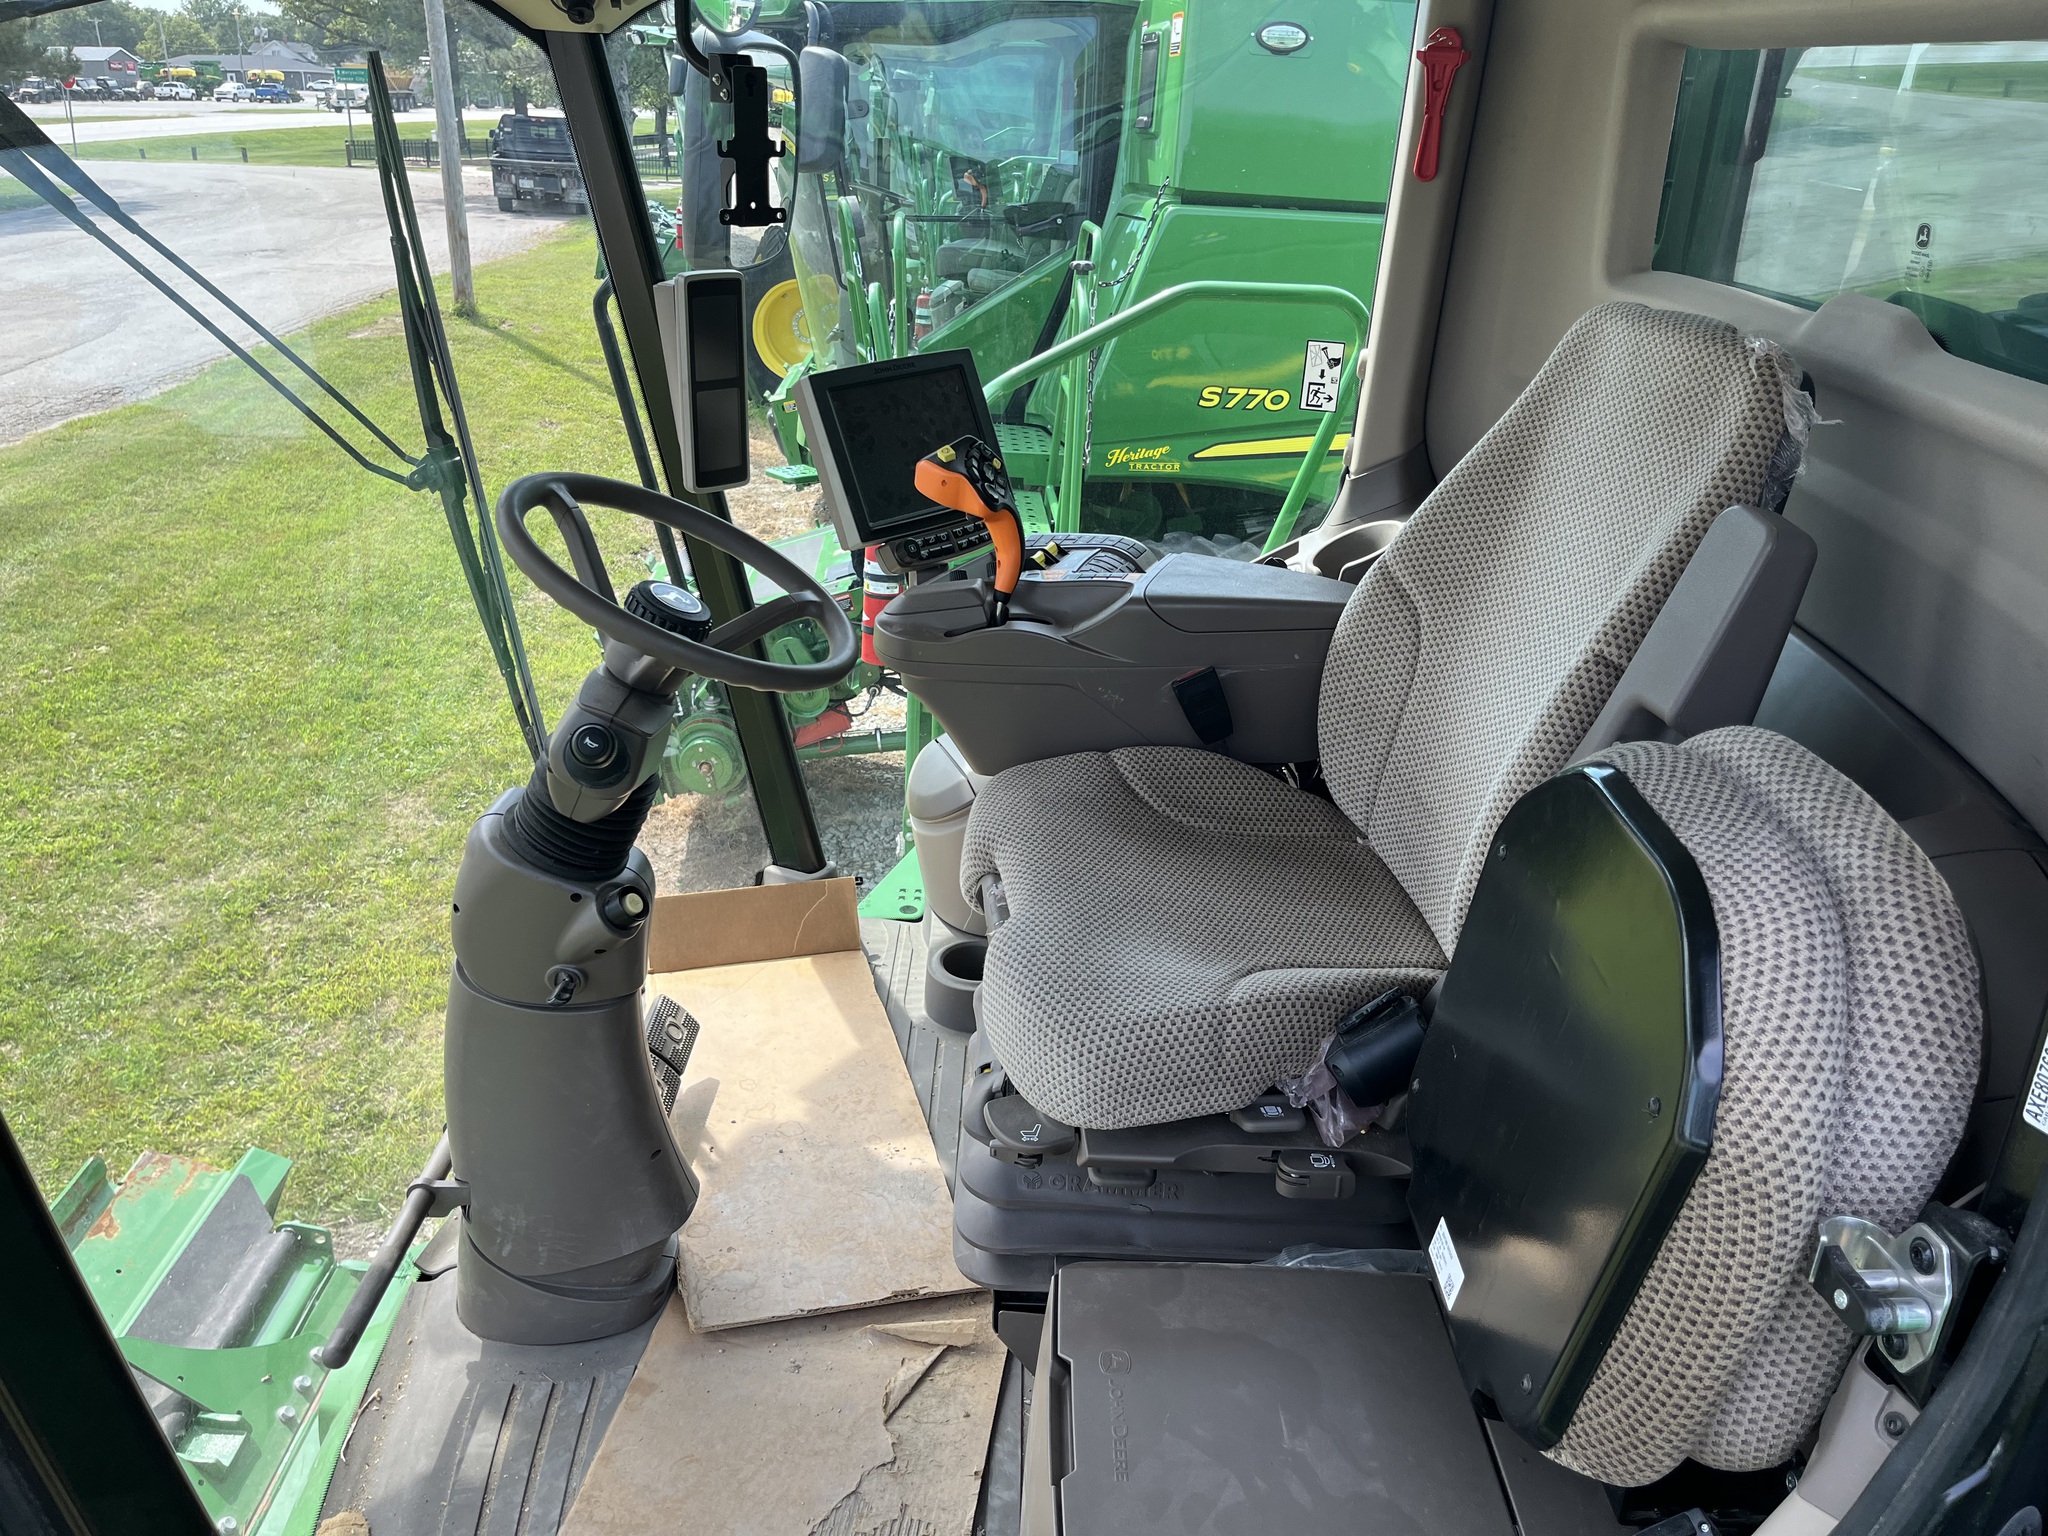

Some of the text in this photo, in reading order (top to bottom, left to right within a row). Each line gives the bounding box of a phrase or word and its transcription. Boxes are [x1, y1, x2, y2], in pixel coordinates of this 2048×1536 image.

[1198, 386, 1291, 411] S770
[1105, 445, 1172, 468] Heritage
[1129, 463, 1180, 471] TRACTOR
[1108, 1379, 1129, 1482] JOHN DEERE
